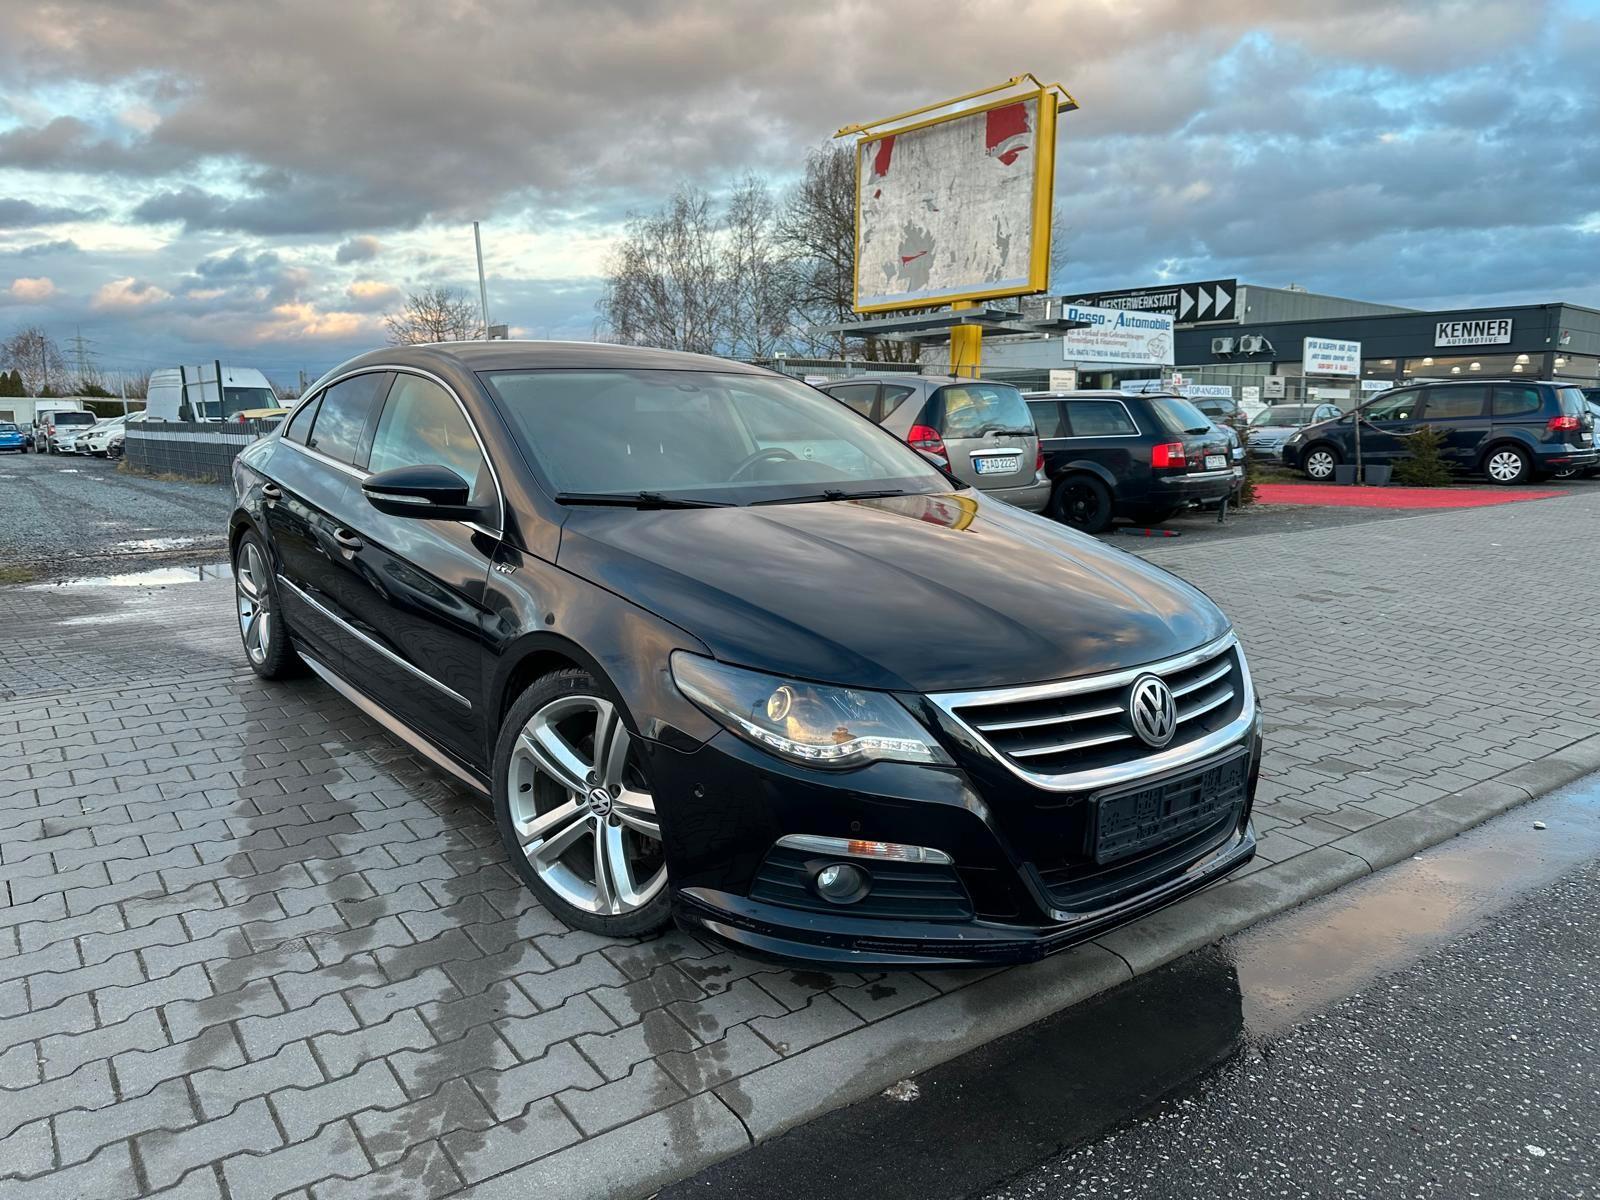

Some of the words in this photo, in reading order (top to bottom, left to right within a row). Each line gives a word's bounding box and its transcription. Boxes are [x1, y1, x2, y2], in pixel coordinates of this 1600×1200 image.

[1113, 312, 1171, 330] Automobile
[1439, 320, 1509, 338] KENNER
[1446, 336, 1497, 345] AUTOMOTIVE
[1189, 385, 1231, 396] TOP-ANGEBOTE
